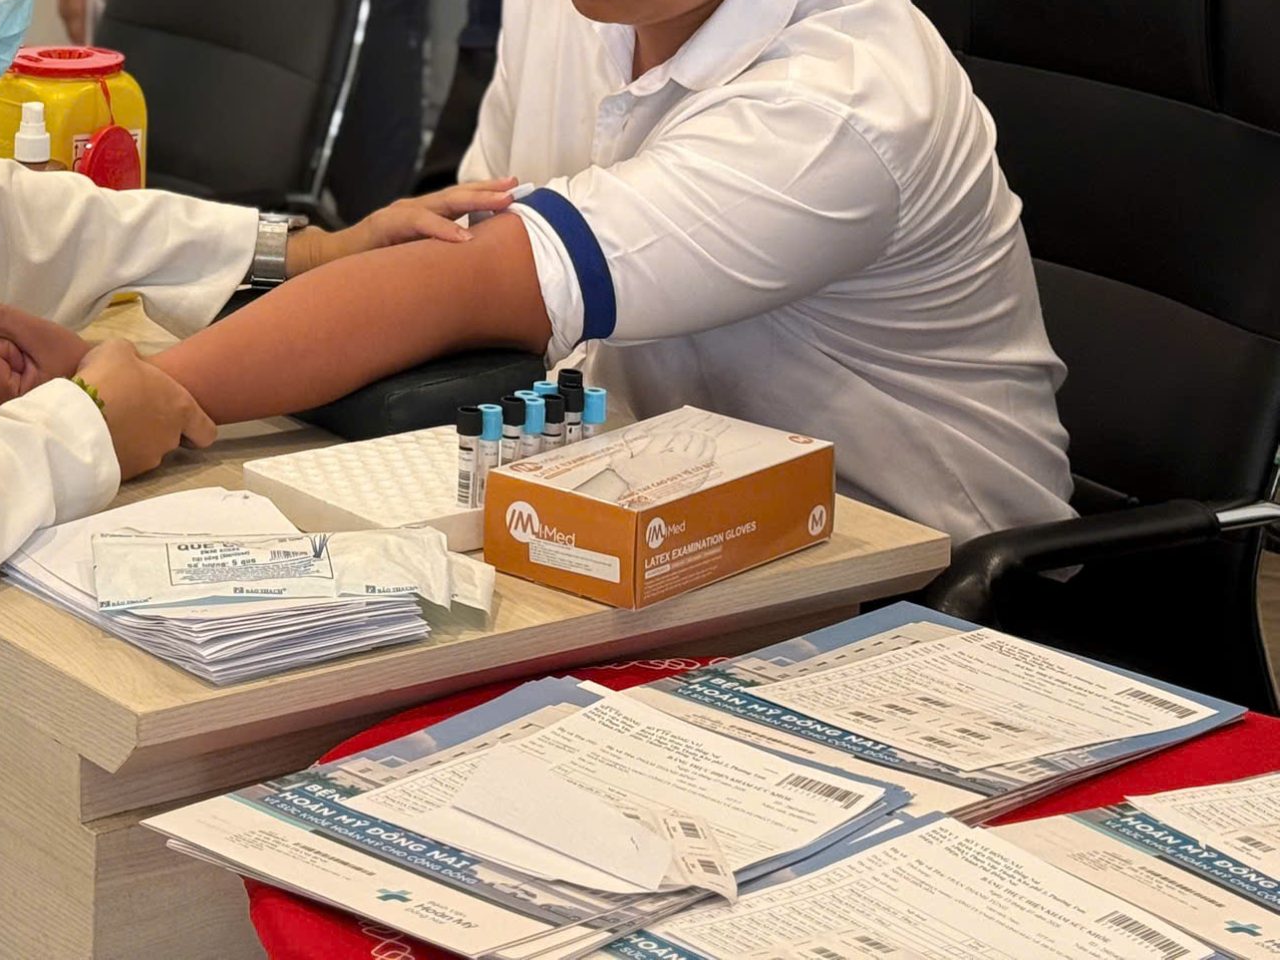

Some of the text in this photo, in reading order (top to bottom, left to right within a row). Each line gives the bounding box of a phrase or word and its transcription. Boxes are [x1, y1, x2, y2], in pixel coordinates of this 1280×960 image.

[644, 520, 757, 570] LATEX EXAMINATION GLOVES
[688, 685, 745, 705] HOÀN
[746, 703, 779, 716] MỸ
[843, 735, 886, 750] NAI
[278, 792, 470, 868] HOÀN MỸ ĐỒNG NAI
[383, 846, 407, 857] CHO
[1120, 817, 1180, 845] HOÀN
[1179, 844, 1218, 860] MỸ
[1214, 861, 1277, 889] ĐỒNG
[1229, 877, 1258, 891] CHO
